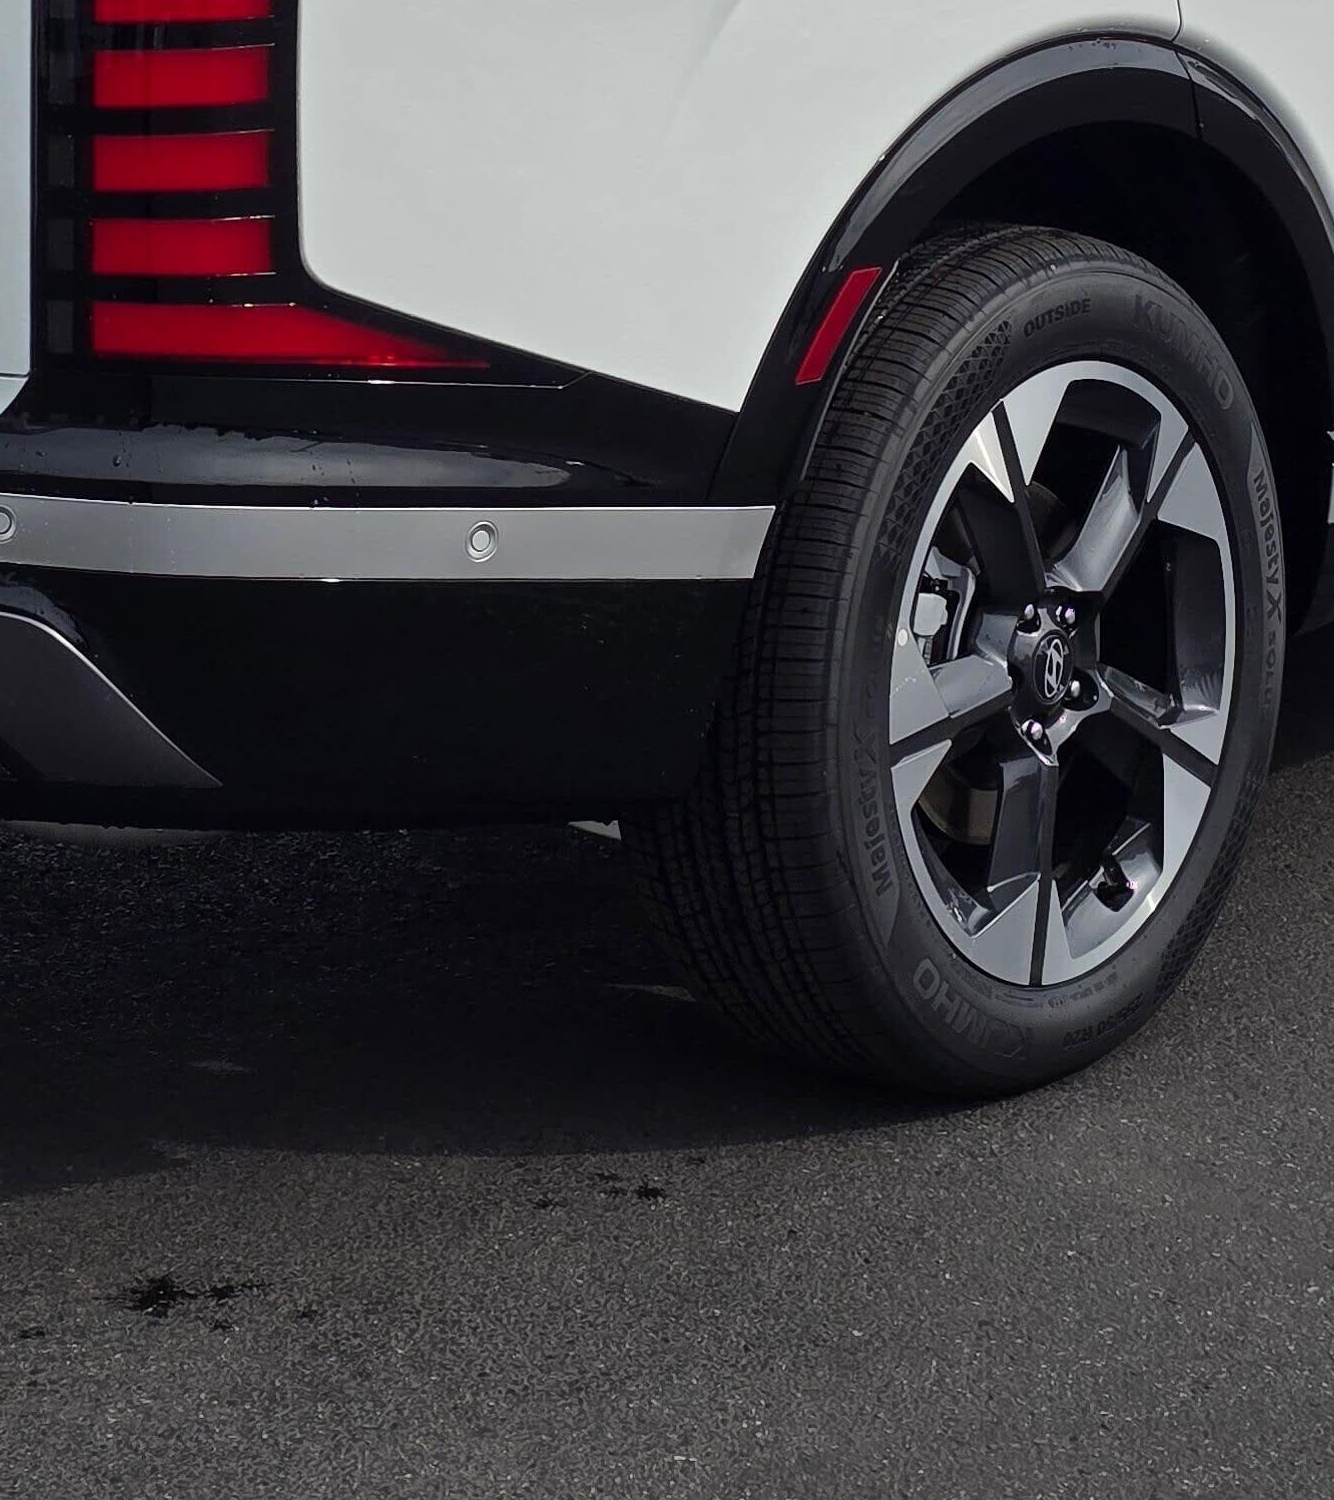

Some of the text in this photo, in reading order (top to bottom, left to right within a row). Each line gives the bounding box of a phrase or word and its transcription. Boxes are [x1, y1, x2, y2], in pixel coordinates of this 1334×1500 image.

[1023, 299, 1091, 338] OUTSIDE
[1253, 469, 1280, 584] Majesty
[1267, 588, 1282, 623] X
